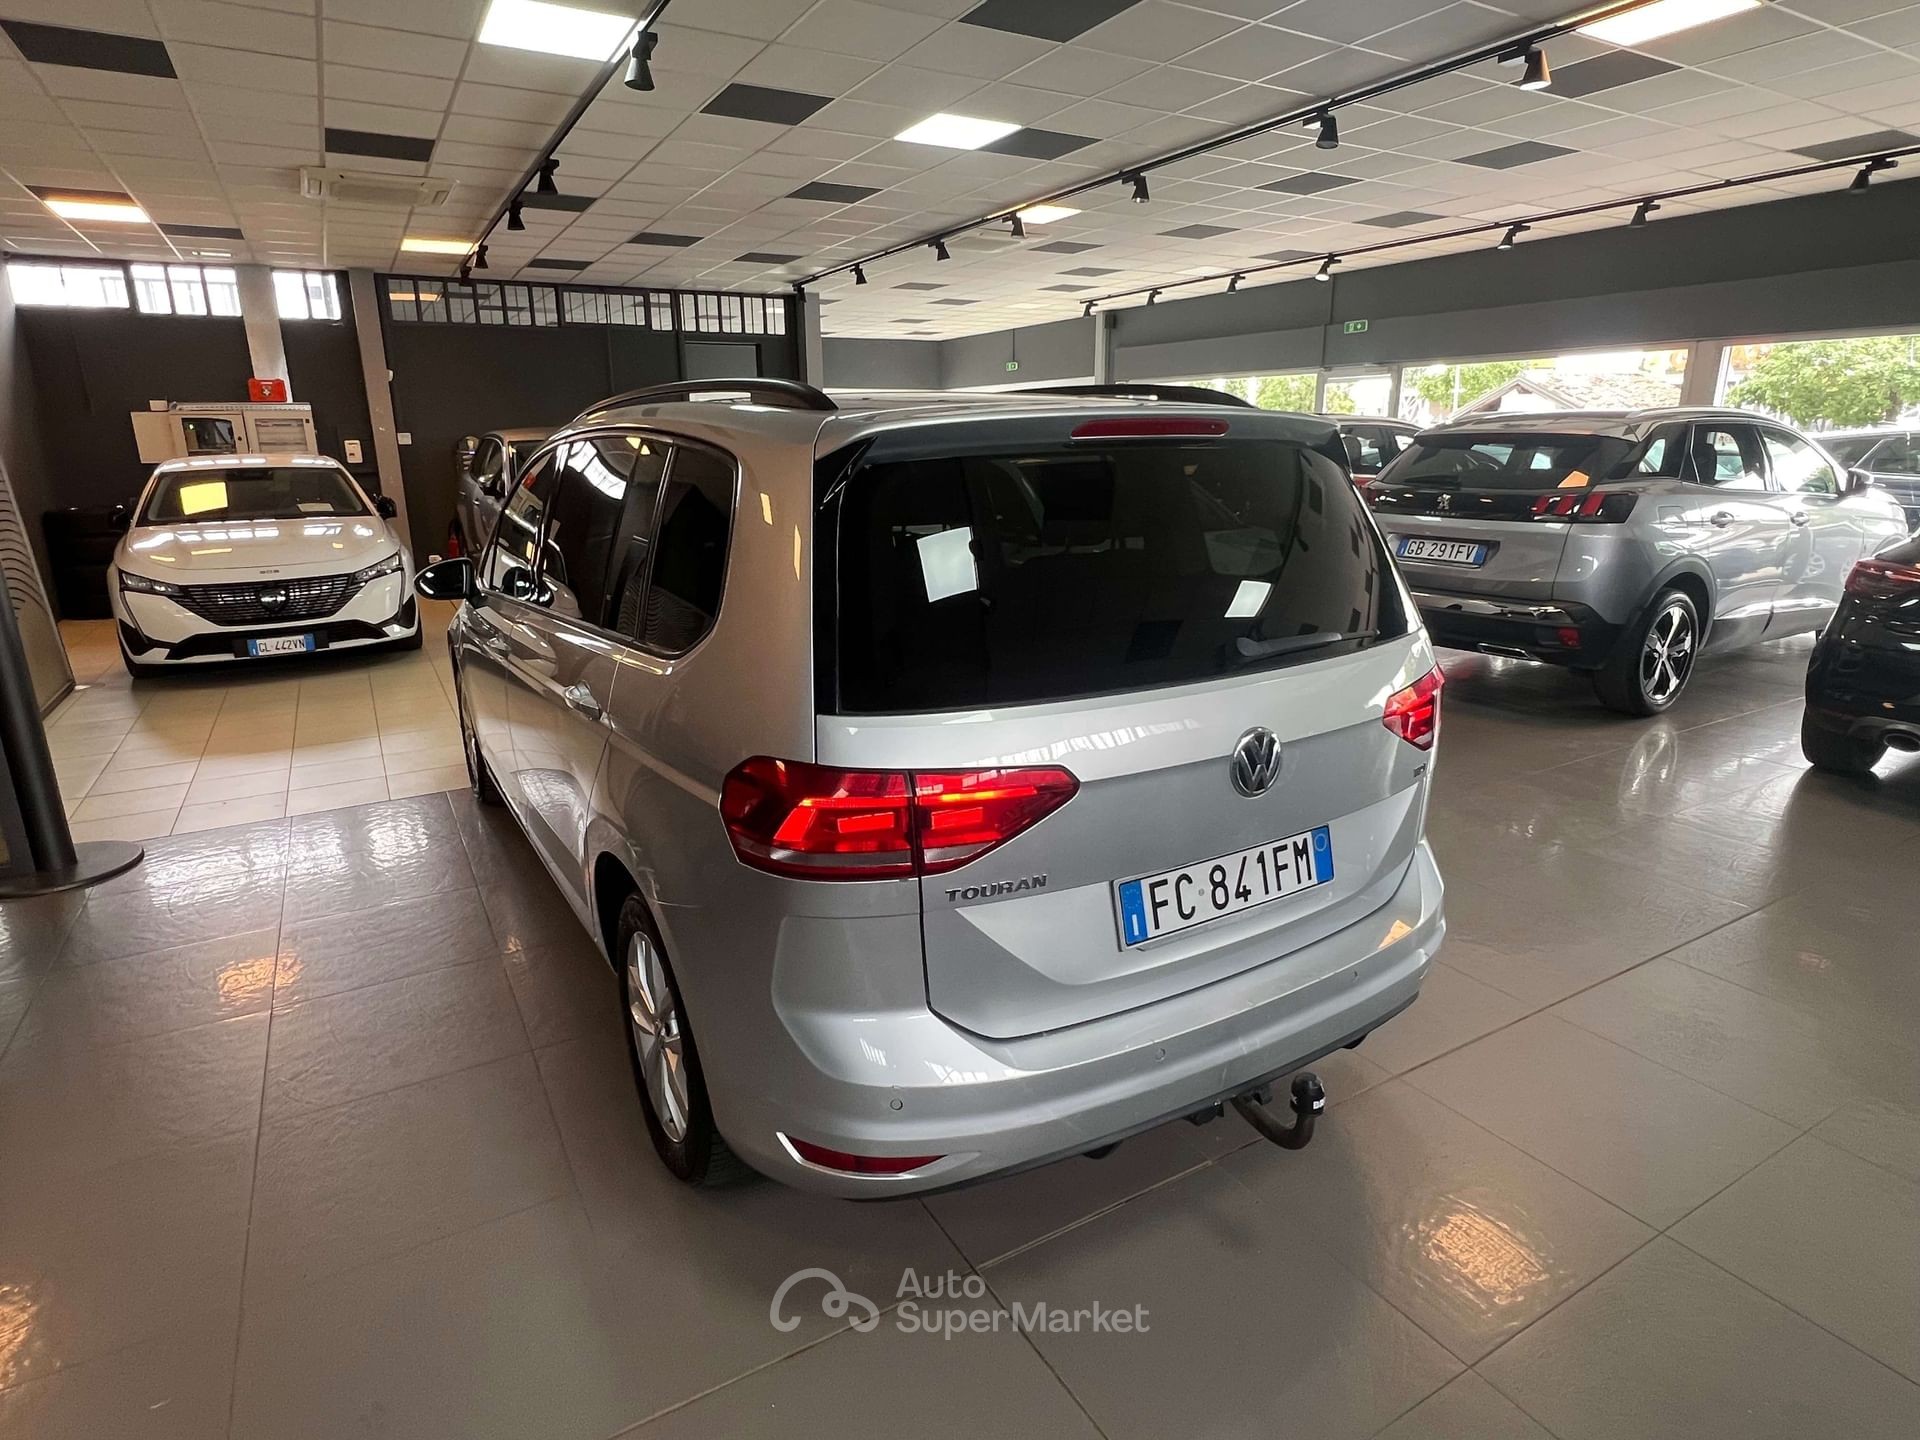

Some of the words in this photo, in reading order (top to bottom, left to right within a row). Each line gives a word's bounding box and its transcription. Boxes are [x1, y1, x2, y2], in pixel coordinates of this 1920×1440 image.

[1407, 541, 1425, 556] GB
[1427, 543, 1476, 561] 291FV
[945, 873, 1048, 903] TOURAN
[1148, 873, 1196, 930] FC
[1210, 836, 1313, 911] 841FM
